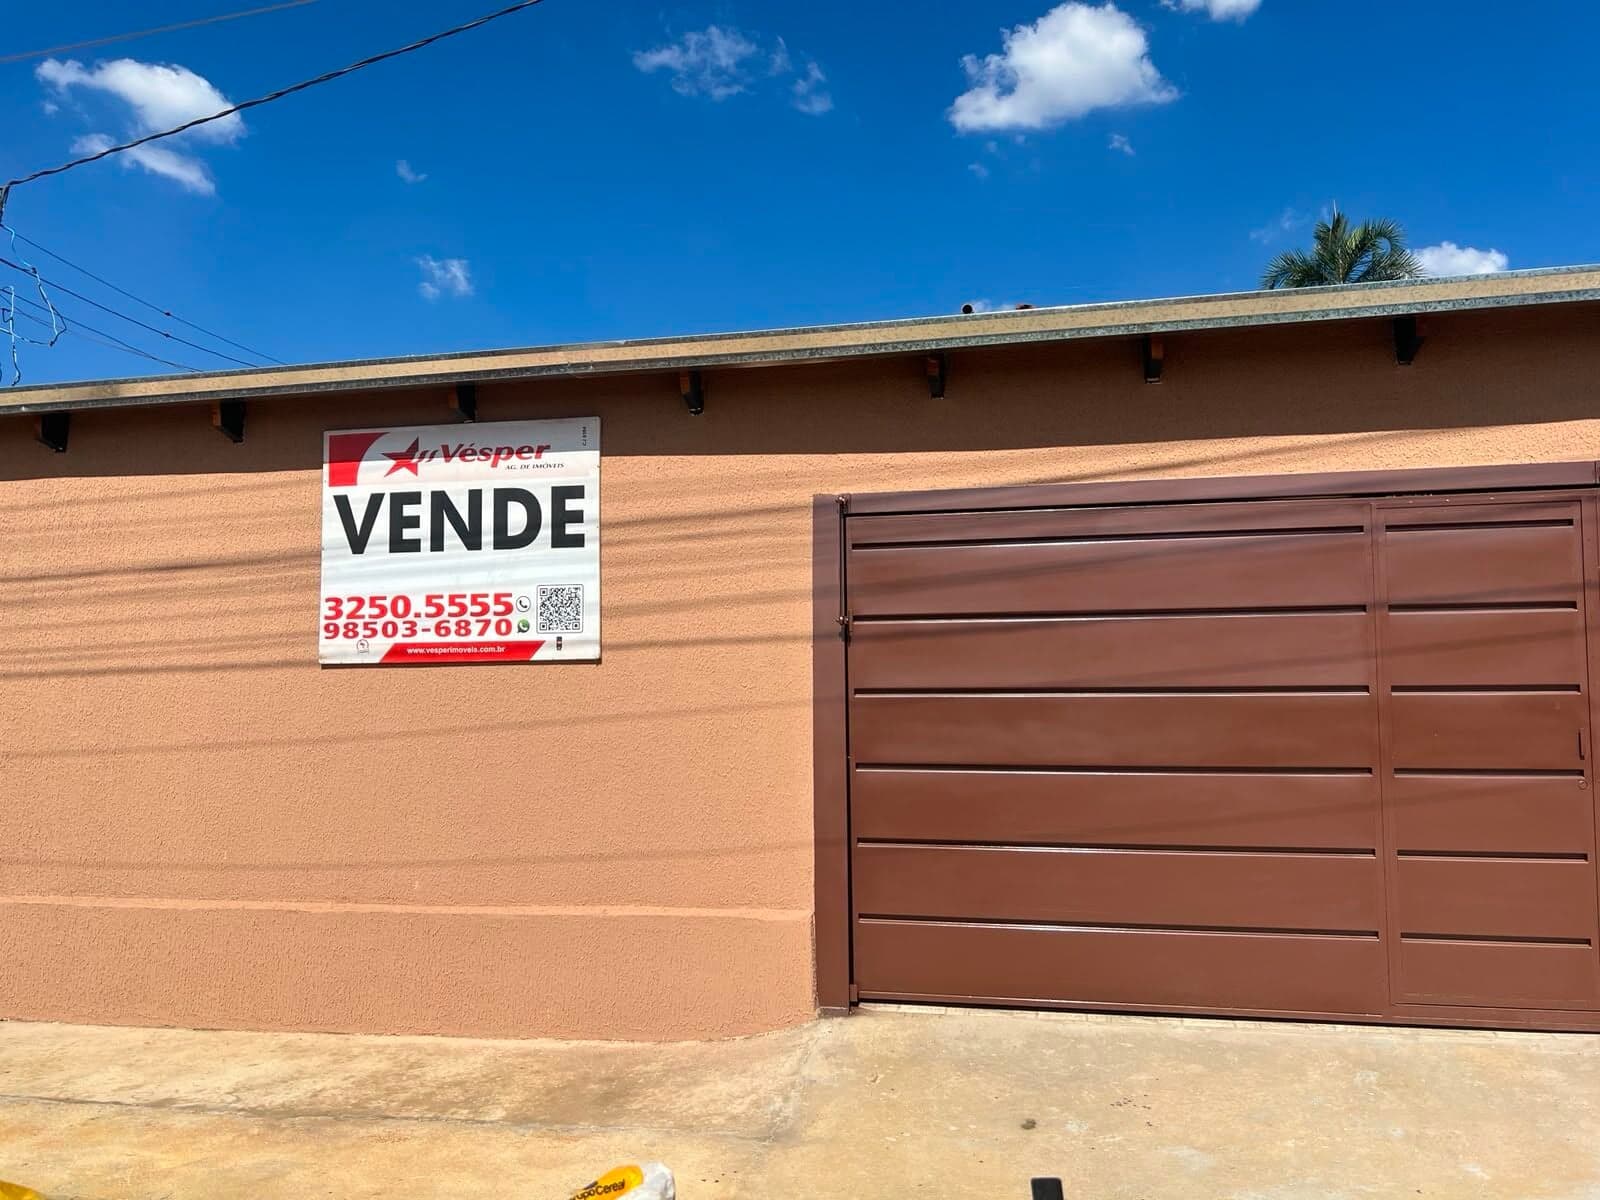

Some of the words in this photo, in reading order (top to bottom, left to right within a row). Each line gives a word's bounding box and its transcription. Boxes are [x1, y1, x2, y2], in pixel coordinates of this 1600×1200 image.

[440, 441, 551, 468] Vésper
[532, 462, 565, 470] IMÓVEIS
[333, 485, 585, 554] VENDE
[323, 592, 514, 619] 3250.5555
[323, 618, 512, 639] 98503-6870
[406, 646, 505, 655] www.vesperimoveis.com.br
[569, 1178, 625, 1200] rupoCereal
